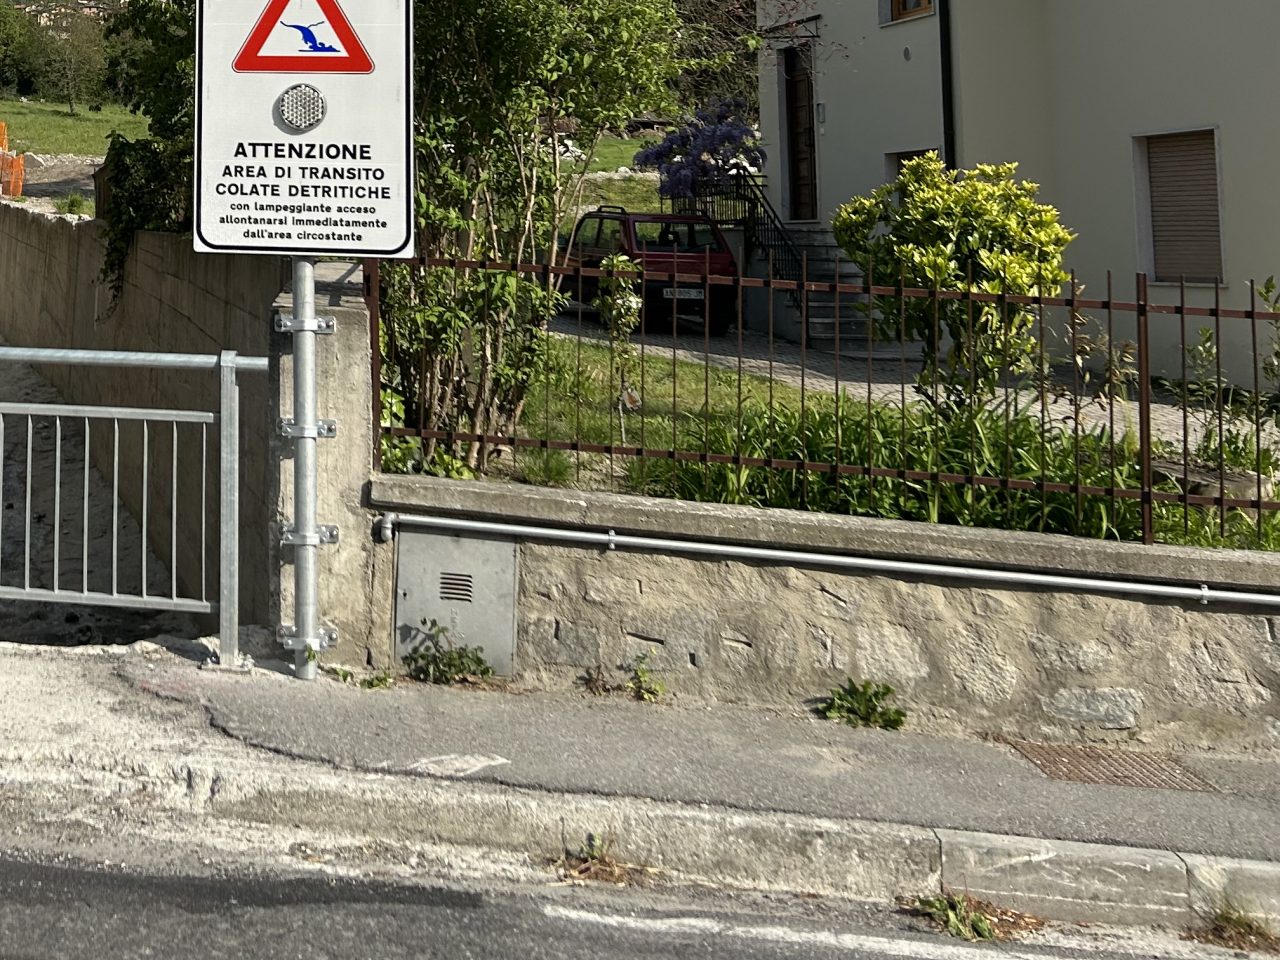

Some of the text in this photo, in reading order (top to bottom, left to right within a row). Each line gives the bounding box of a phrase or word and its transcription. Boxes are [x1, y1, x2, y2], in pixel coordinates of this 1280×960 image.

[233, 142, 372, 161] ATTENZIONE
[222, 165, 385, 181] AREA DI TRANSITO
[215, 183, 391, 200] COLATE DETRITICHE
[230, 201, 376, 214] con lampeggiante acceso
[219, 214, 388, 229] allontanarsi immediatamente
[242, 229, 363, 242] dall'area circostante
